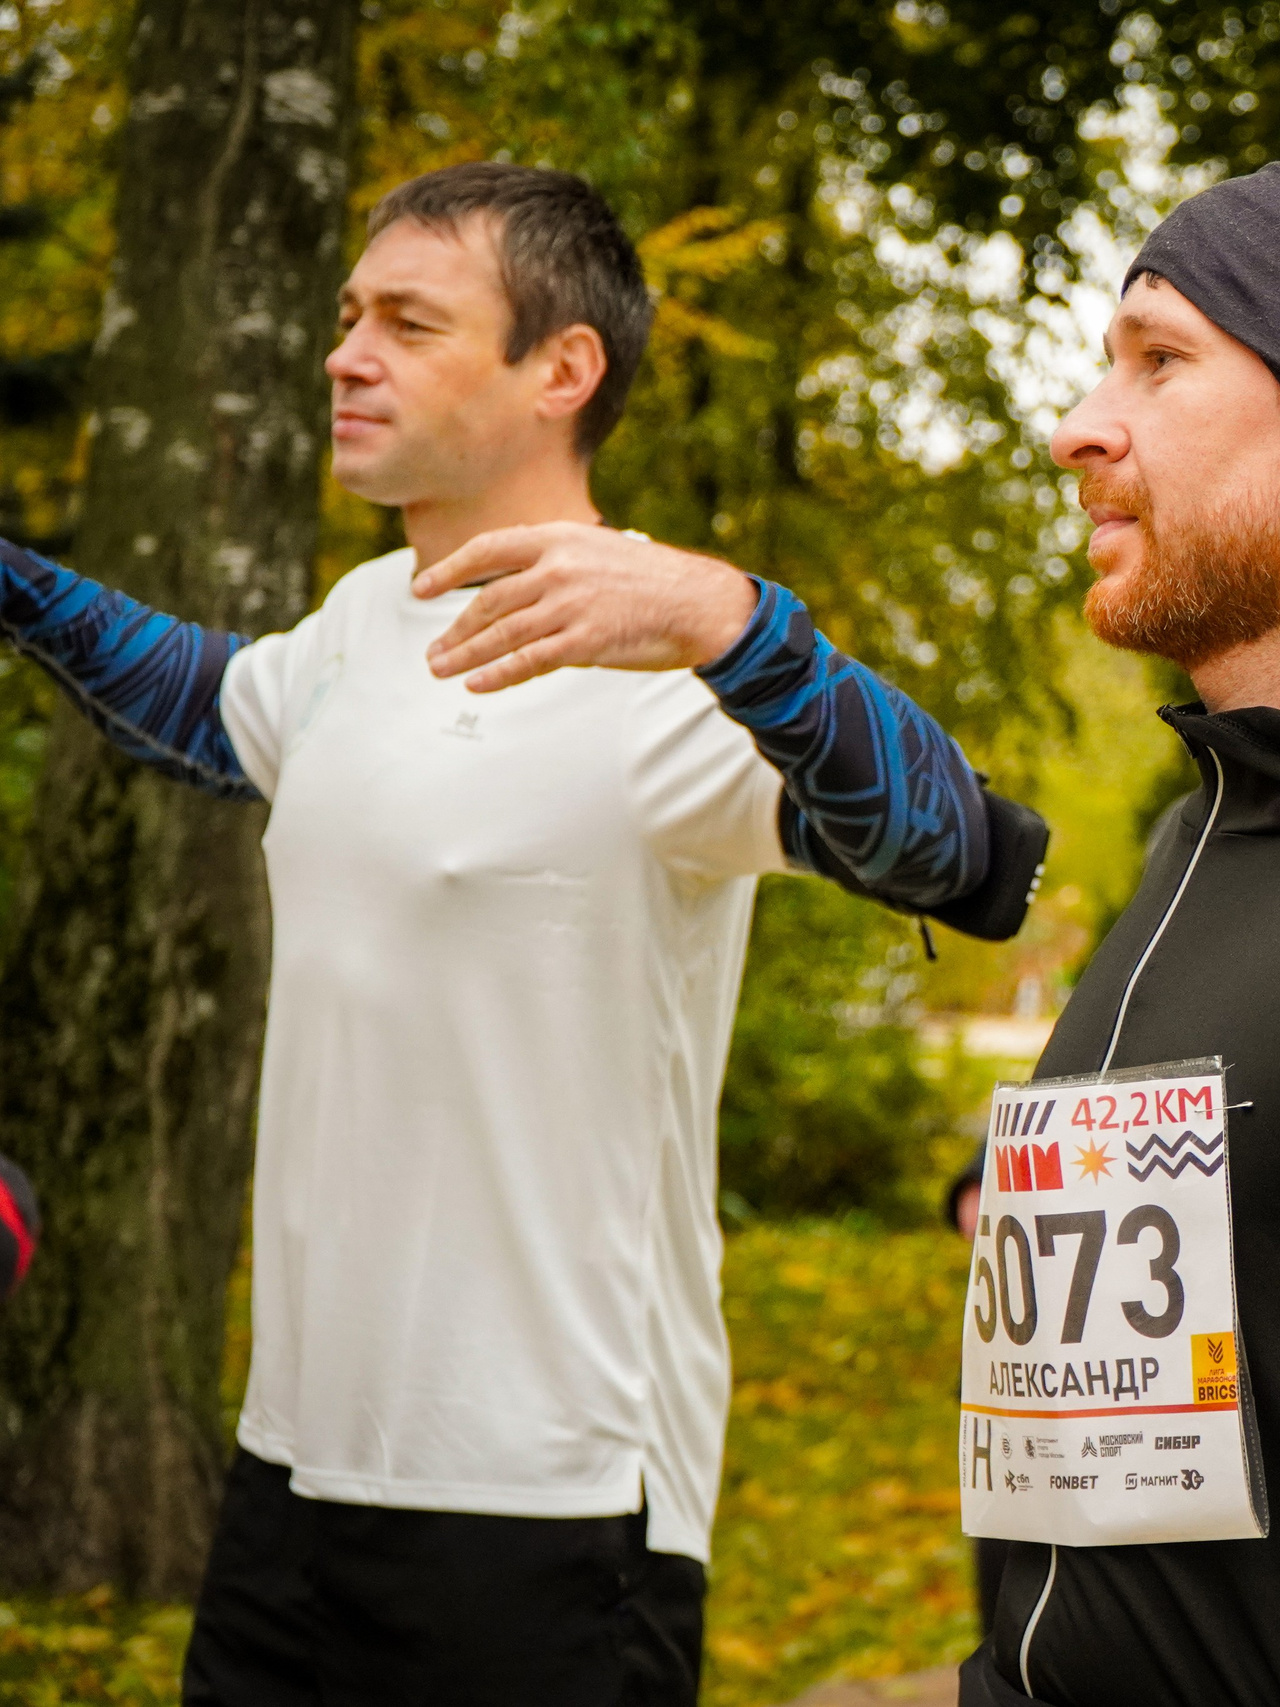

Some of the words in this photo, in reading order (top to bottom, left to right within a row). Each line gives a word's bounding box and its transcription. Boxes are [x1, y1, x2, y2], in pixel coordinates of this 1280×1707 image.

[974, 1204, 1185, 1346] 5073
[990, 1357, 1160, 1401] АЛЕКСАНДР
[1198, 1384, 1237, 1401] BRICS
[1099, 1431, 1143, 1446] МОСКОВСКИЙ
[1154, 1435, 1201, 1450] СИБУР
[1100, 1446, 1122, 1457] СПОРТ
[1050, 1475, 1099, 1490] FONBET
[1140, 1475, 1179, 1487] МАГНИТ
